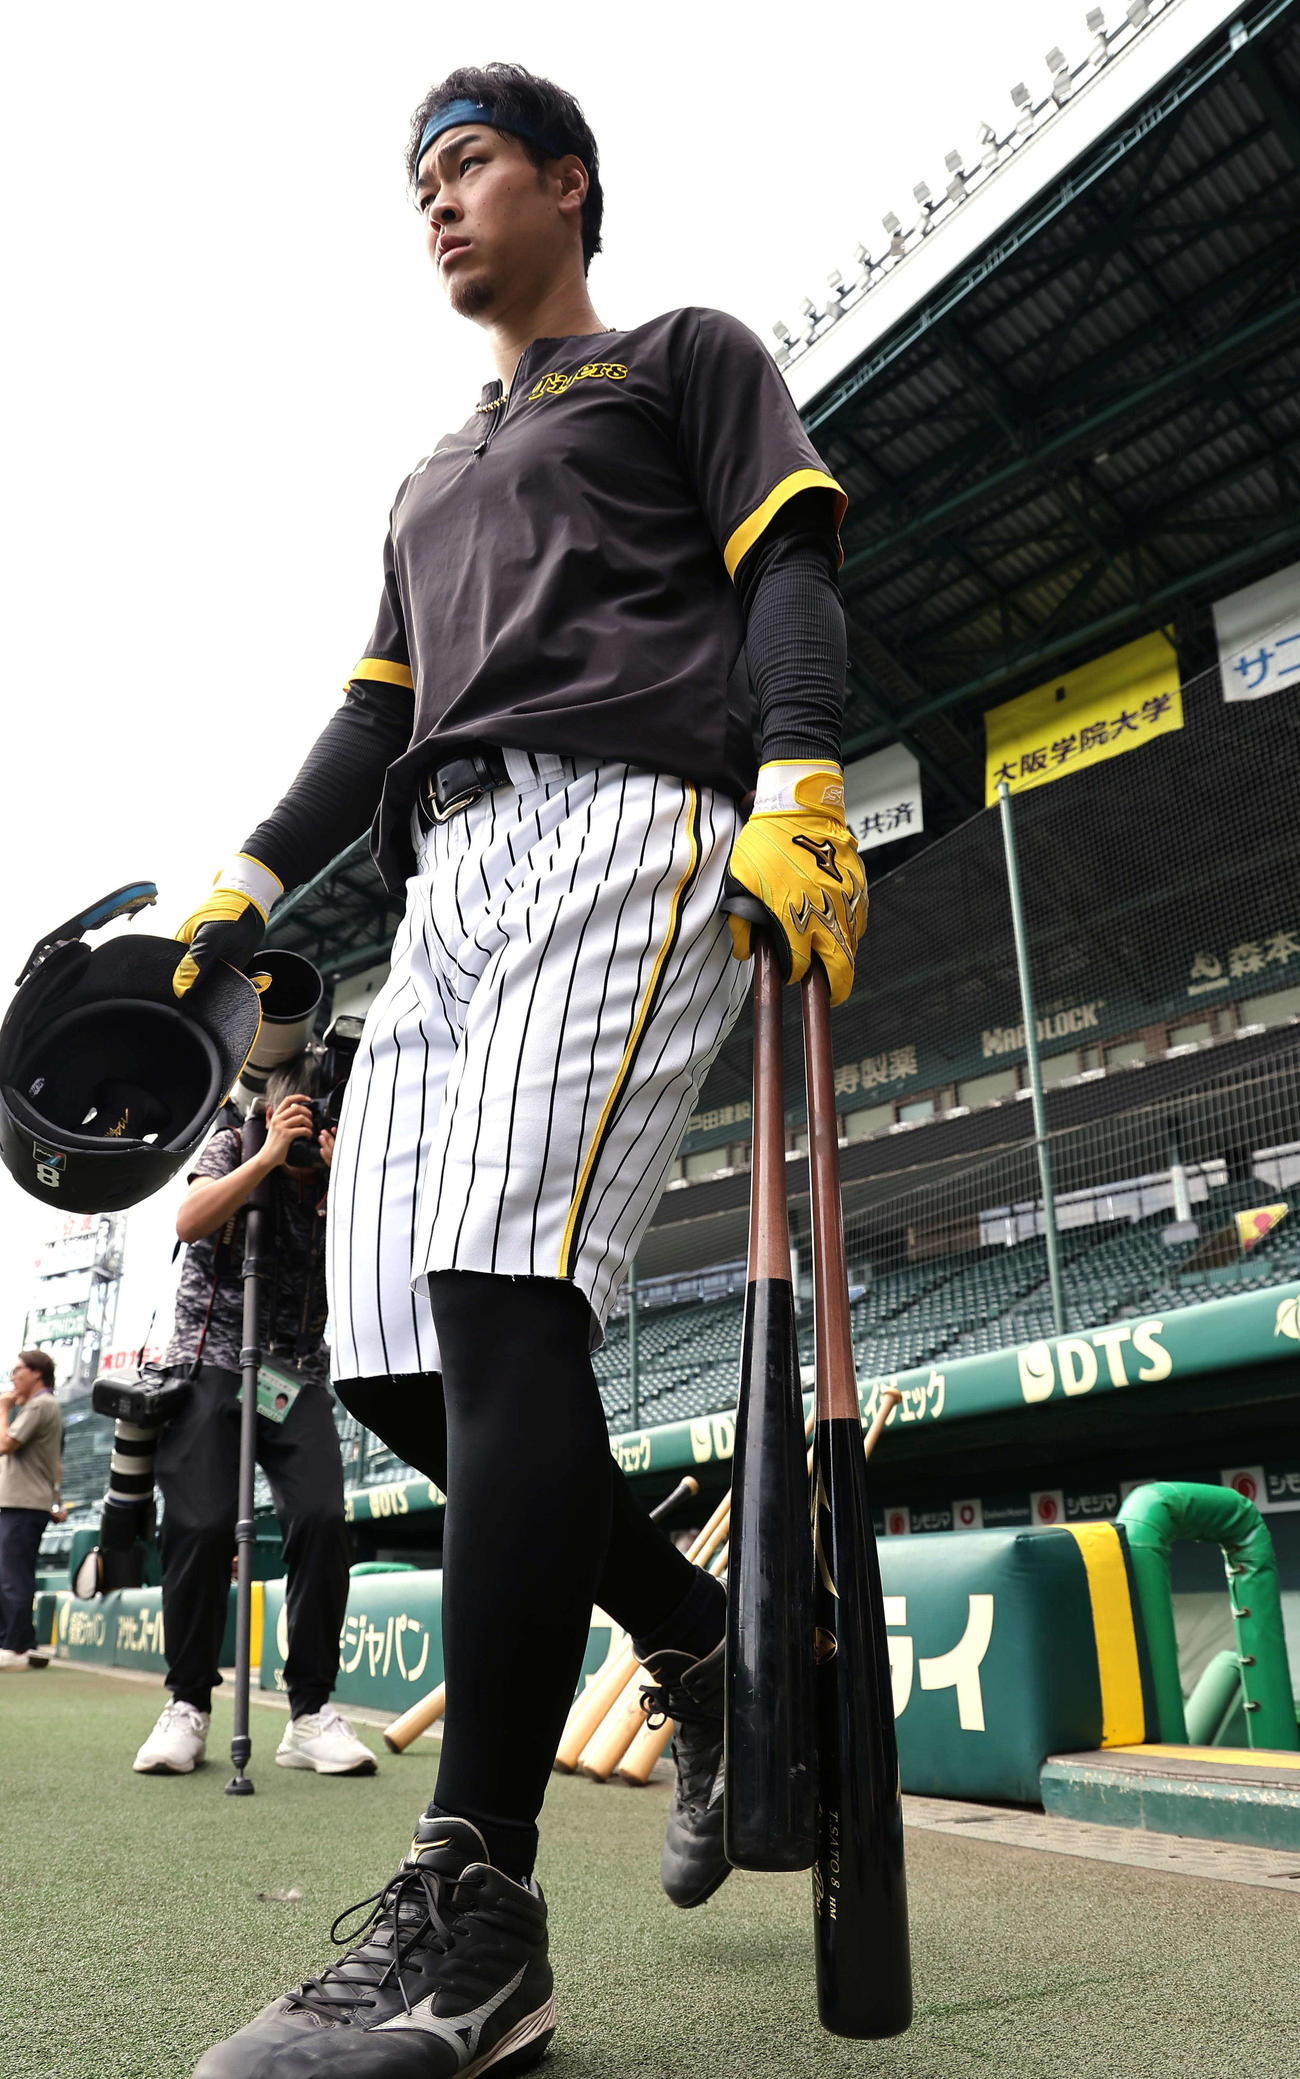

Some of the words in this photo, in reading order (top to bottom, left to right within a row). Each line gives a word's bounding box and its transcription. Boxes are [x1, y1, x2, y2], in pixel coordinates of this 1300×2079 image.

[993, 692, 1172, 789] 大阪学院大学
[36, 1163, 60, 1188] 8
